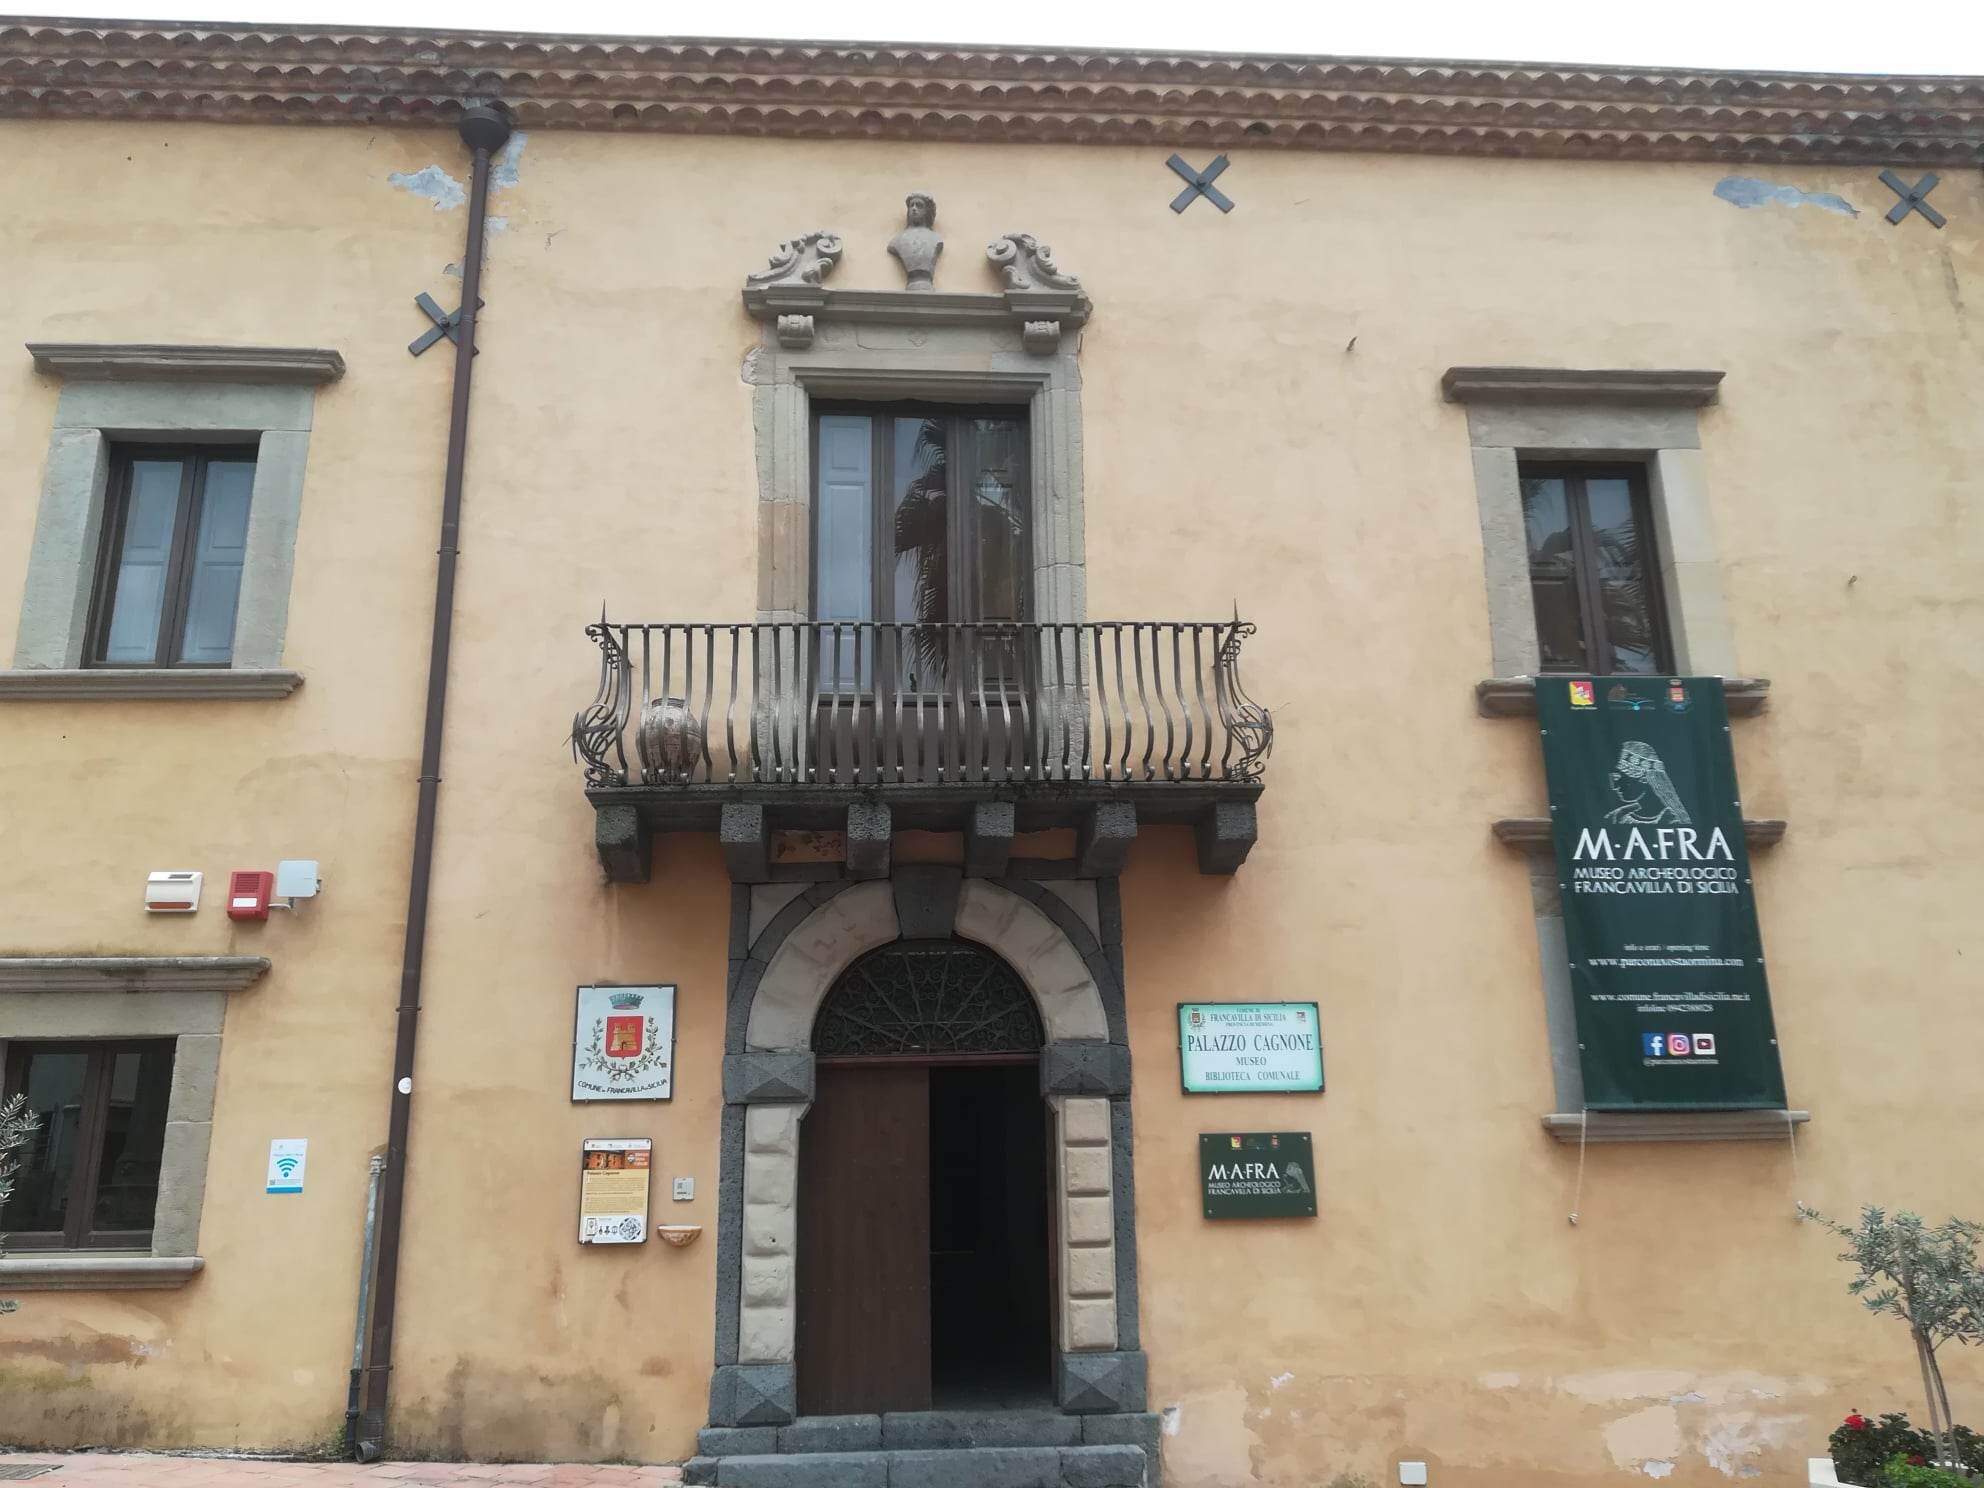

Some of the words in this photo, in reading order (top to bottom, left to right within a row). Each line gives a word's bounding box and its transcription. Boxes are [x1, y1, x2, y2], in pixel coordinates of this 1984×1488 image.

[1573, 867, 1624, 879] MUSEO
[1628, 867, 1738, 879] ARCHEOLOGICO
[1574, 881, 1674, 894] FRANCAVILLA
[1677, 881, 1693, 893] DI
[1697, 881, 1739, 894] SICILIA
[1210, 1013, 1252, 1021] FRANCAVILLA
[1254, 1013, 1262, 1021] DI
[1263, 1013, 1286, 1021] SICILIA
[1188, 1034, 1246, 1052] PALAZZO
[1254, 1034, 1313, 1051] CAGNONE
[1236, 1056, 1266, 1066] MUSEO
[1205, 1071, 1251, 1080] BIBLIOTECA
[1257, 1071, 1300, 1080] COMUNALE
[578, 1080, 602, 1093] COMUNE
[606, 1085, 646, 1094] FRANCAVILLA
[648, 1078, 667, 1090] SICILIA
